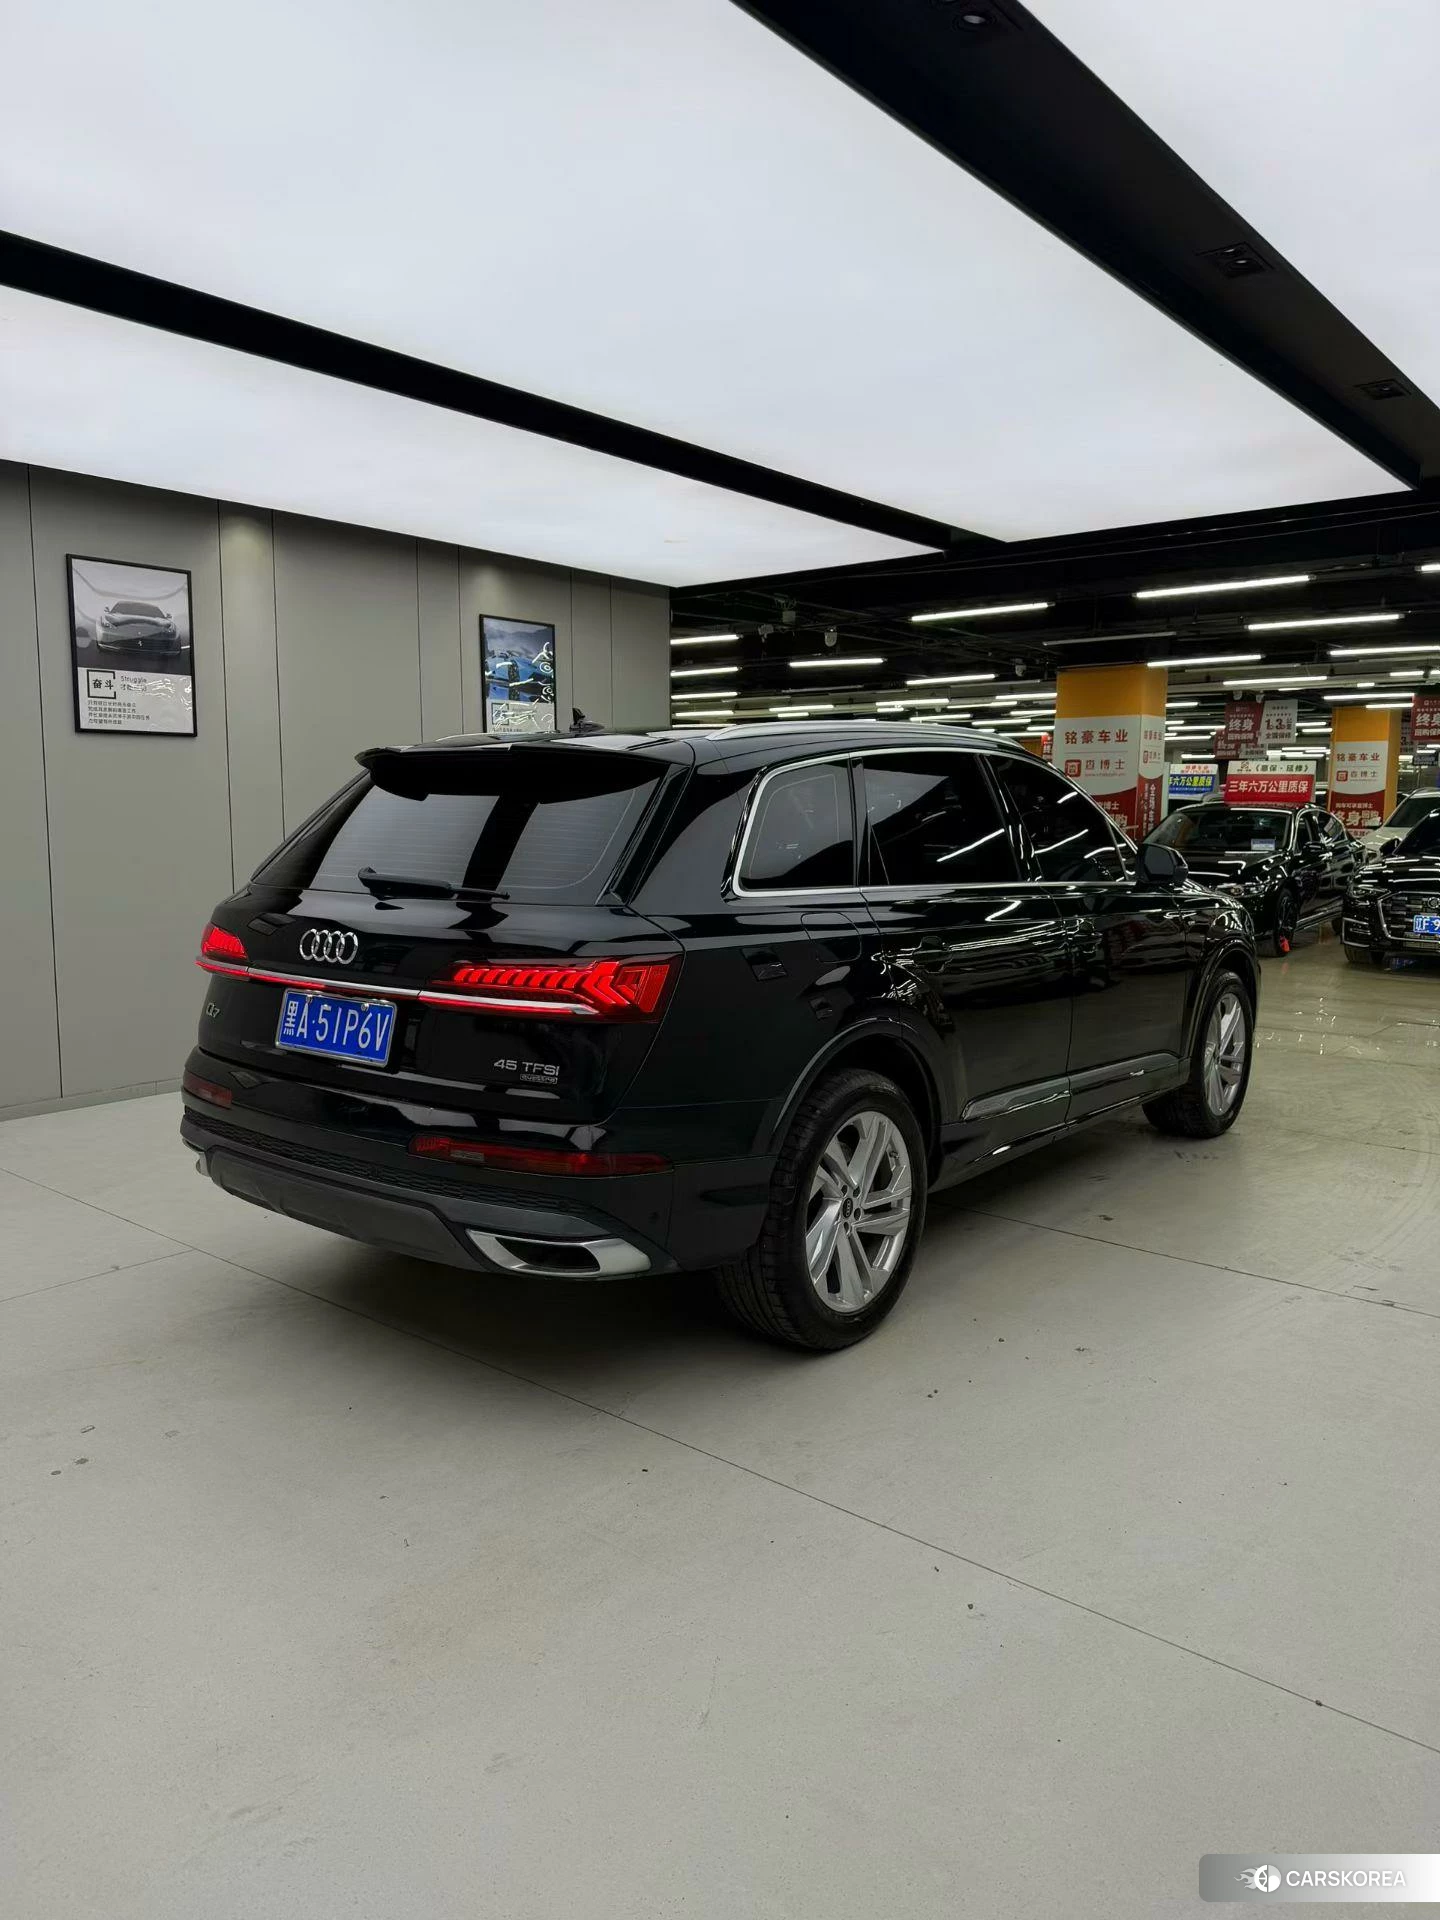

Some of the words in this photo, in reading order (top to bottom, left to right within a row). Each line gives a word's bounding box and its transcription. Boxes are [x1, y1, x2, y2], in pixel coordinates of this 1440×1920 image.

[92, 679, 114, 690] 奋斗
[1228, 718, 1254, 731] 终身
[1064, 729, 1128, 744] 铭豪车业
[1336, 752, 1380, 762] 铭豪车业
[1228, 780, 1309, 793] 三年六万公里质保
[205, 1002, 221, 1018] Q7
[493, 1059, 518, 1071] 45
[521, 1061, 560, 1076] TFSI
